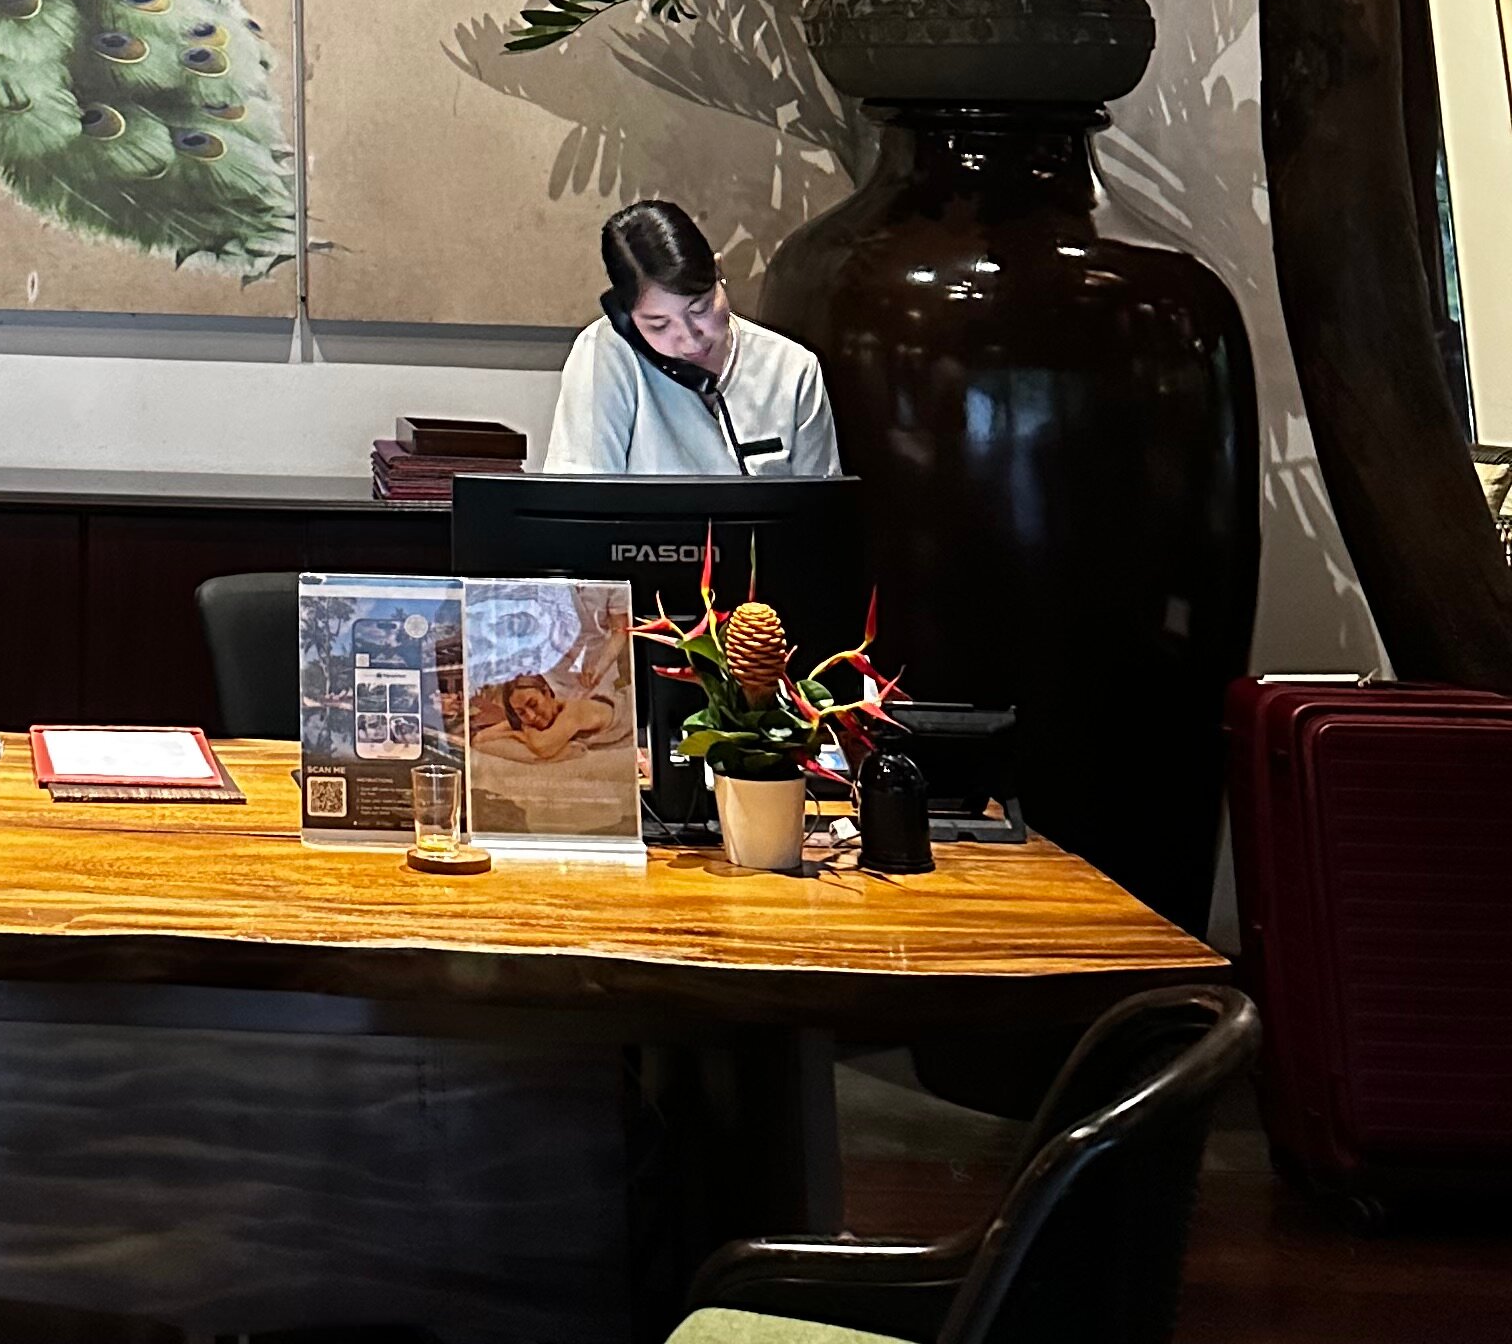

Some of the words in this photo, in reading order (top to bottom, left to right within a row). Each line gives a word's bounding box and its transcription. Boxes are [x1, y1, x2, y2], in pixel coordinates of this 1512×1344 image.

[611, 544, 720, 562] IPASON
[307, 765, 332, 774] SCAN
[333, 766, 346, 774] ME
